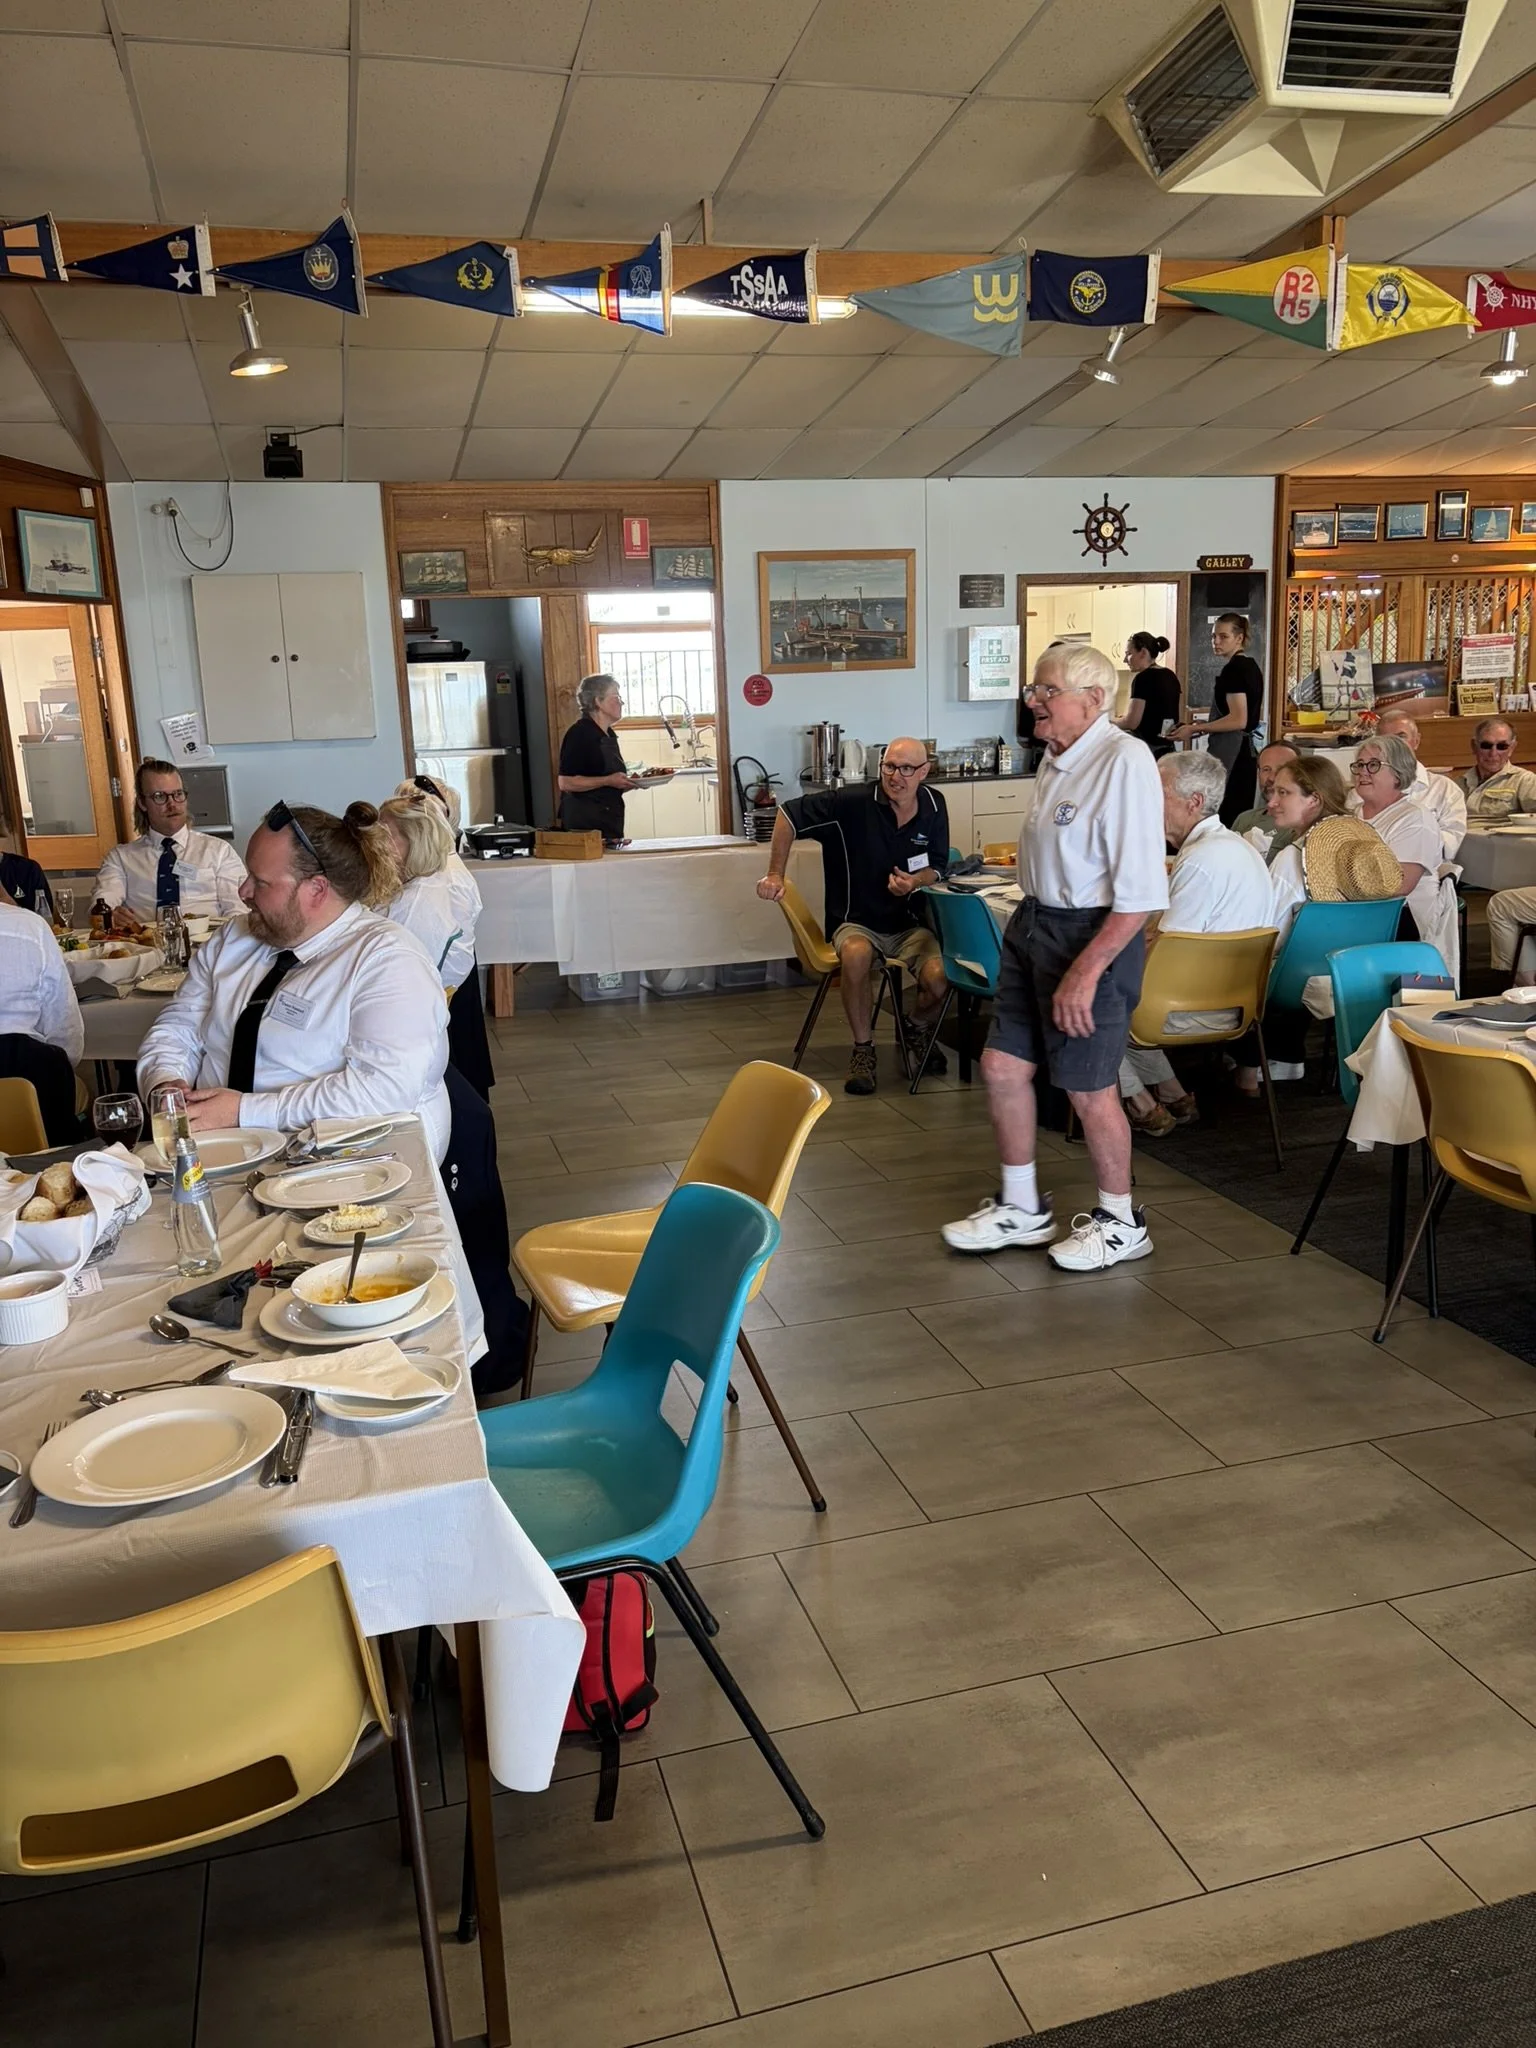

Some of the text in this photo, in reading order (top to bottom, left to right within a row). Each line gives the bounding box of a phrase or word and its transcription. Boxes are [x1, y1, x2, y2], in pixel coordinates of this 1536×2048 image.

[730, 264, 788, 303] TSSAA
[1205, 557, 1245, 568] GALLEY
[1105, 1233, 1124, 1251] N
